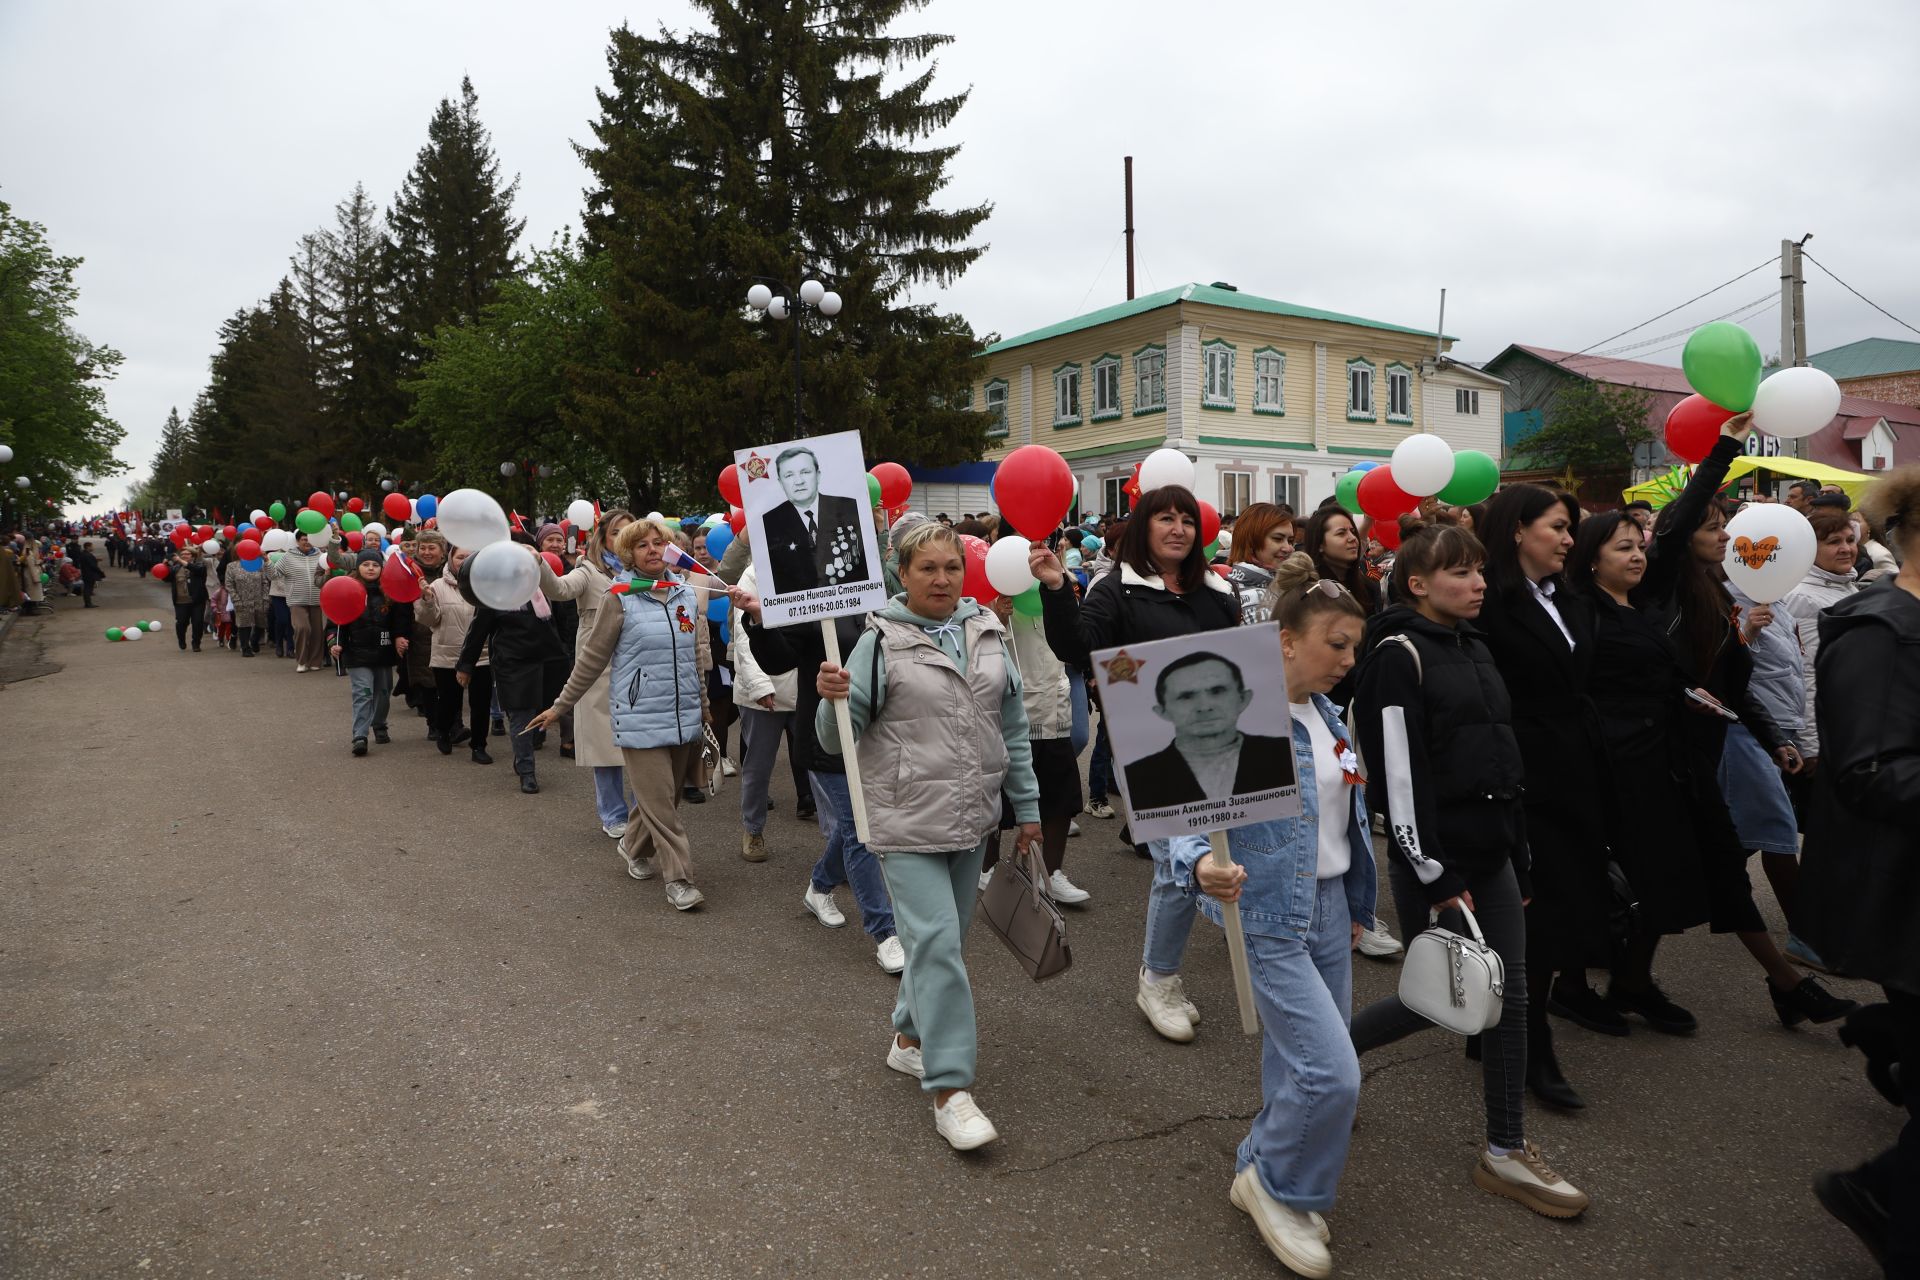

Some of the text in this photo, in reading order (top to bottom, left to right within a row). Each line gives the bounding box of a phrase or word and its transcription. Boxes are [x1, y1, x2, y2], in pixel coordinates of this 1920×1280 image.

[763, 581, 883, 607] Овсянников Николай Степанович
[788, 597, 862, 617] 07.12.1916-20.05.1984
[1134, 788, 1298, 822] Зиганшин Ахметша Зиганшинович
[1187, 811, 1248, 828] 1910-1980 г.г.
